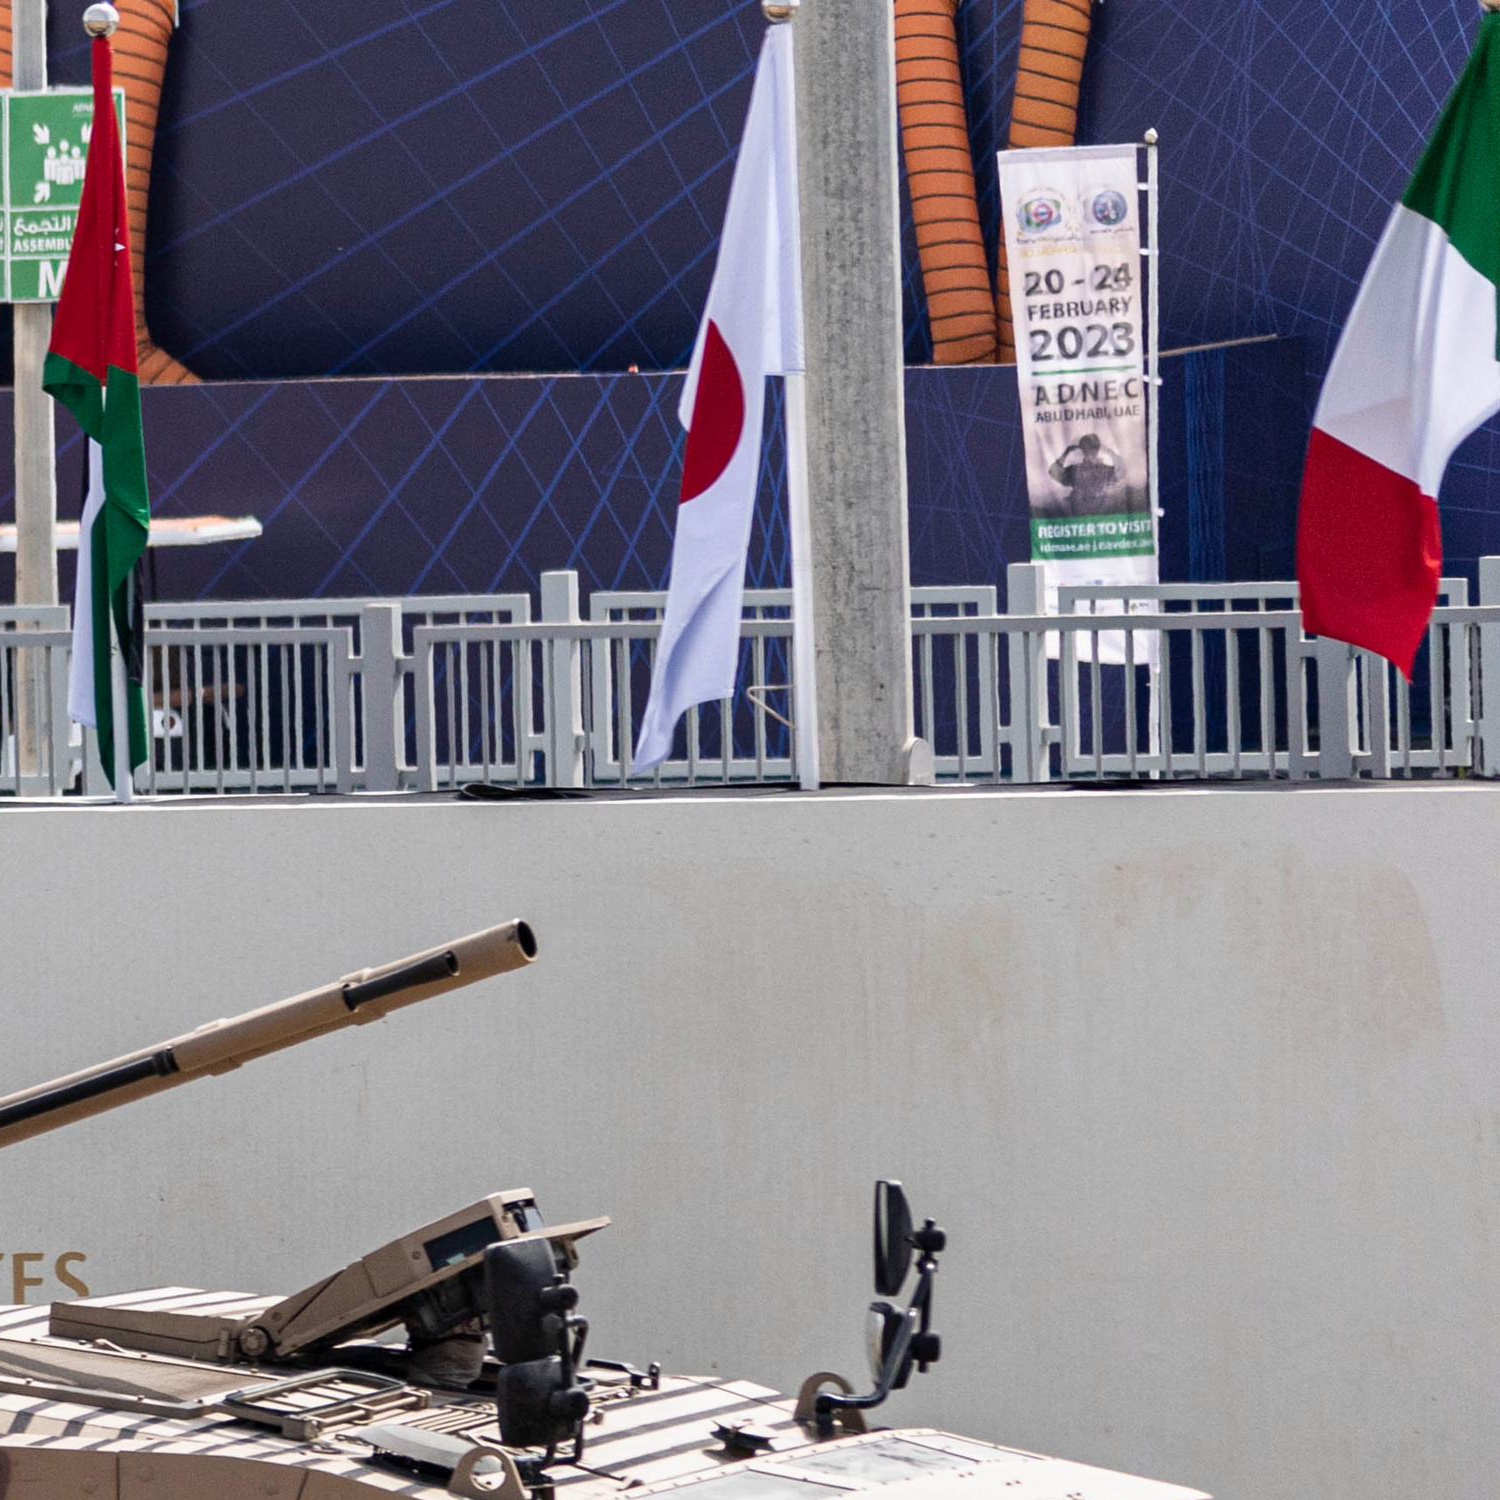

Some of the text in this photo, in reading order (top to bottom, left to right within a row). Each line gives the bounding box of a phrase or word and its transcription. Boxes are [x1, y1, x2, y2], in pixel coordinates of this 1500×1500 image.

[13, 214, 71, 236] التجمع
[13, 237, 72, 252] ASSEMBL
[38, 260, 69, 298] M
[1024, 269, 1064, 296] 20
[1094, 263, 1132, 291] 24
[1027, 297, 1132, 321] FEBRUARY
[1029, 322, 1135, 361] 2023
[1035, 378, 1139, 407] ADNEC
[1114, 404, 1140, 418] UAE
[1038, 523, 1095, 539] REGISTER
[1097, 521, 1117, 535] TO
